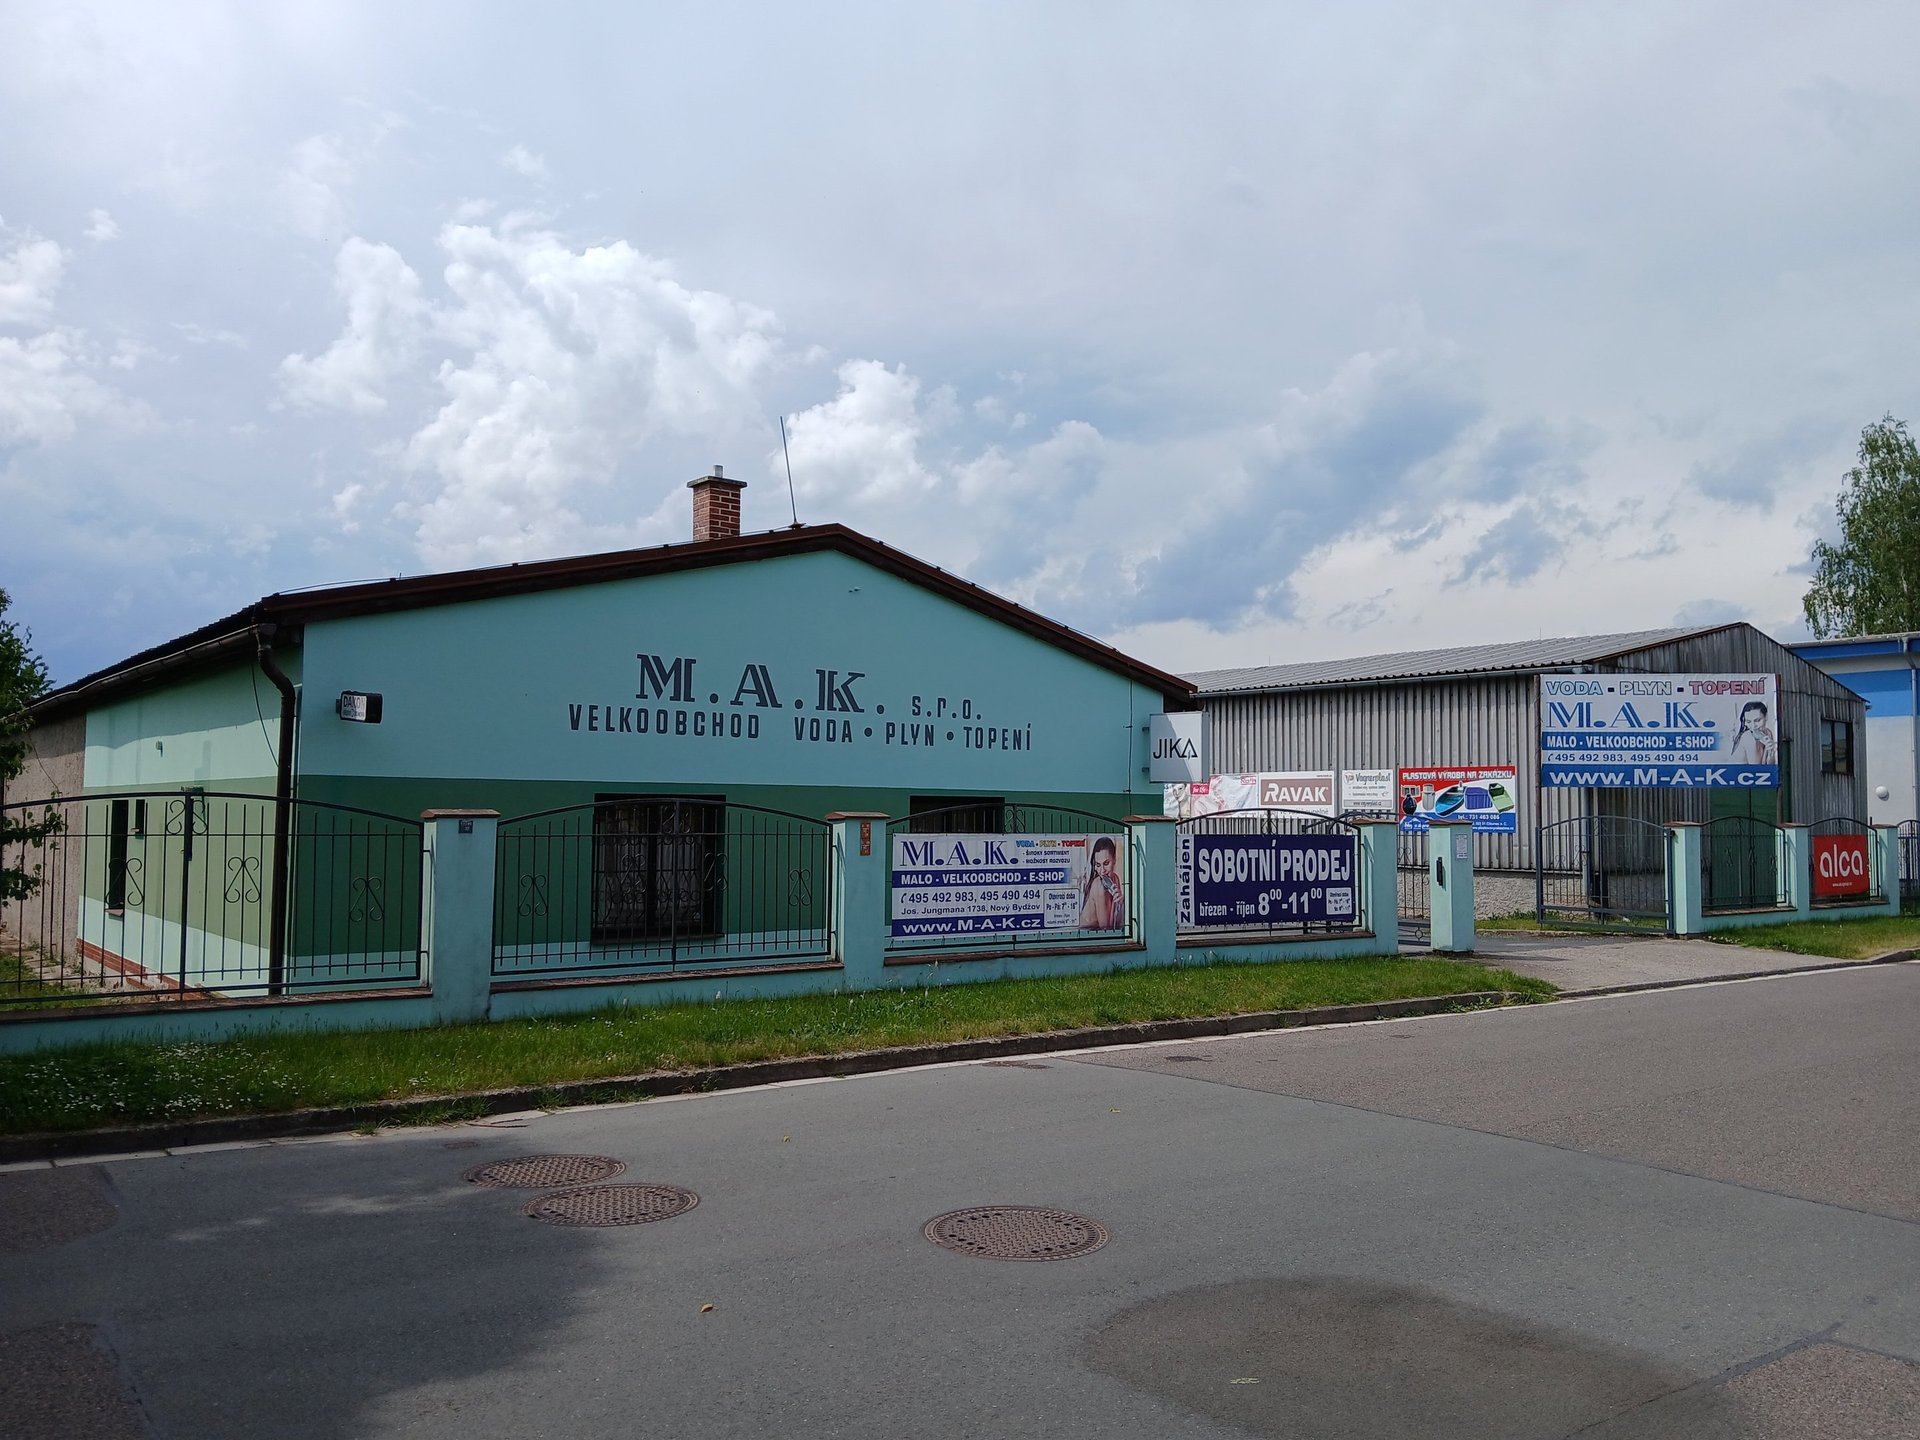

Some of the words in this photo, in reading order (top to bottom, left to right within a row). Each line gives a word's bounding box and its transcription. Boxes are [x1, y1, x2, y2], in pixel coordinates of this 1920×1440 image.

[635, 653, 886, 716] M.A.K.
[1546, 680, 1604, 696] VODA
[1619, 680, 1672, 696] PLYN
[1688, 676, 1768, 696] TOPENÍ
[1546, 701, 1716, 729] M.A.K.
[568, 703, 760, 739] VELKOOBCHOD
[794, 716, 853, 743] VODA
[886, 722, 935, 747] PLYN
[963, 723, 1032, 751] TOPENÍ
[1152, 737, 1199, 759] JIKA
[1546, 735, 1577, 748] MALO
[1585, 735, 1667, 748] VELKOOBCHOD
[1675, 735, 1715, 748] E-SHOP
[1554, 753, 1576, 762] 495
[1578, 753, 1599, 762] 492
[1602, 753, 1627, 763] 983,
[1630, 753, 1651, 762] 495
[1654, 753, 1675, 762] 490
[1678, 753, 1699, 762] 494
[1466, 770, 1477, 779] NA
[1549, 768, 1772, 786] www.M-A-K.cz
[1263, 782, 1327, 802] RAVAK
[900, 840, 1019, 867] M.A.K.
[1198, 839, 1276, 883] SOBOTNÍ
[1280, 848, 1351, 882] PRODEJ
[1819, 843, 1864, 878] alca
[901, 874, 933, 885] MALO
[942, 872, 1021, 884] VELKOOBCHOD
[1029, 871, 1065, 883] E-SHOP
[1179, 838, 1191, 924] Zahájen
[908, 892, 929, 903] 495
[931, 891, 952, 902] 492
[955, 891, 977, 903] 983,
[979, 891, 999, 901] 495
[1001, 890, 1020, 900] 490
[1022, 889, 1041, 900] 494
[921, 907, 965, 916] Jungmana
[967, 905, 988, 913] 1738,
[990, 904, 1010, 913] Nový
[1012, 903, 1041, 912] Bydžov
[1199, 902, 1227, 917] březen
[1235, 901, 1256, 918] říjen
[902, 917, 1041, 934] www.M-A-K.cz
